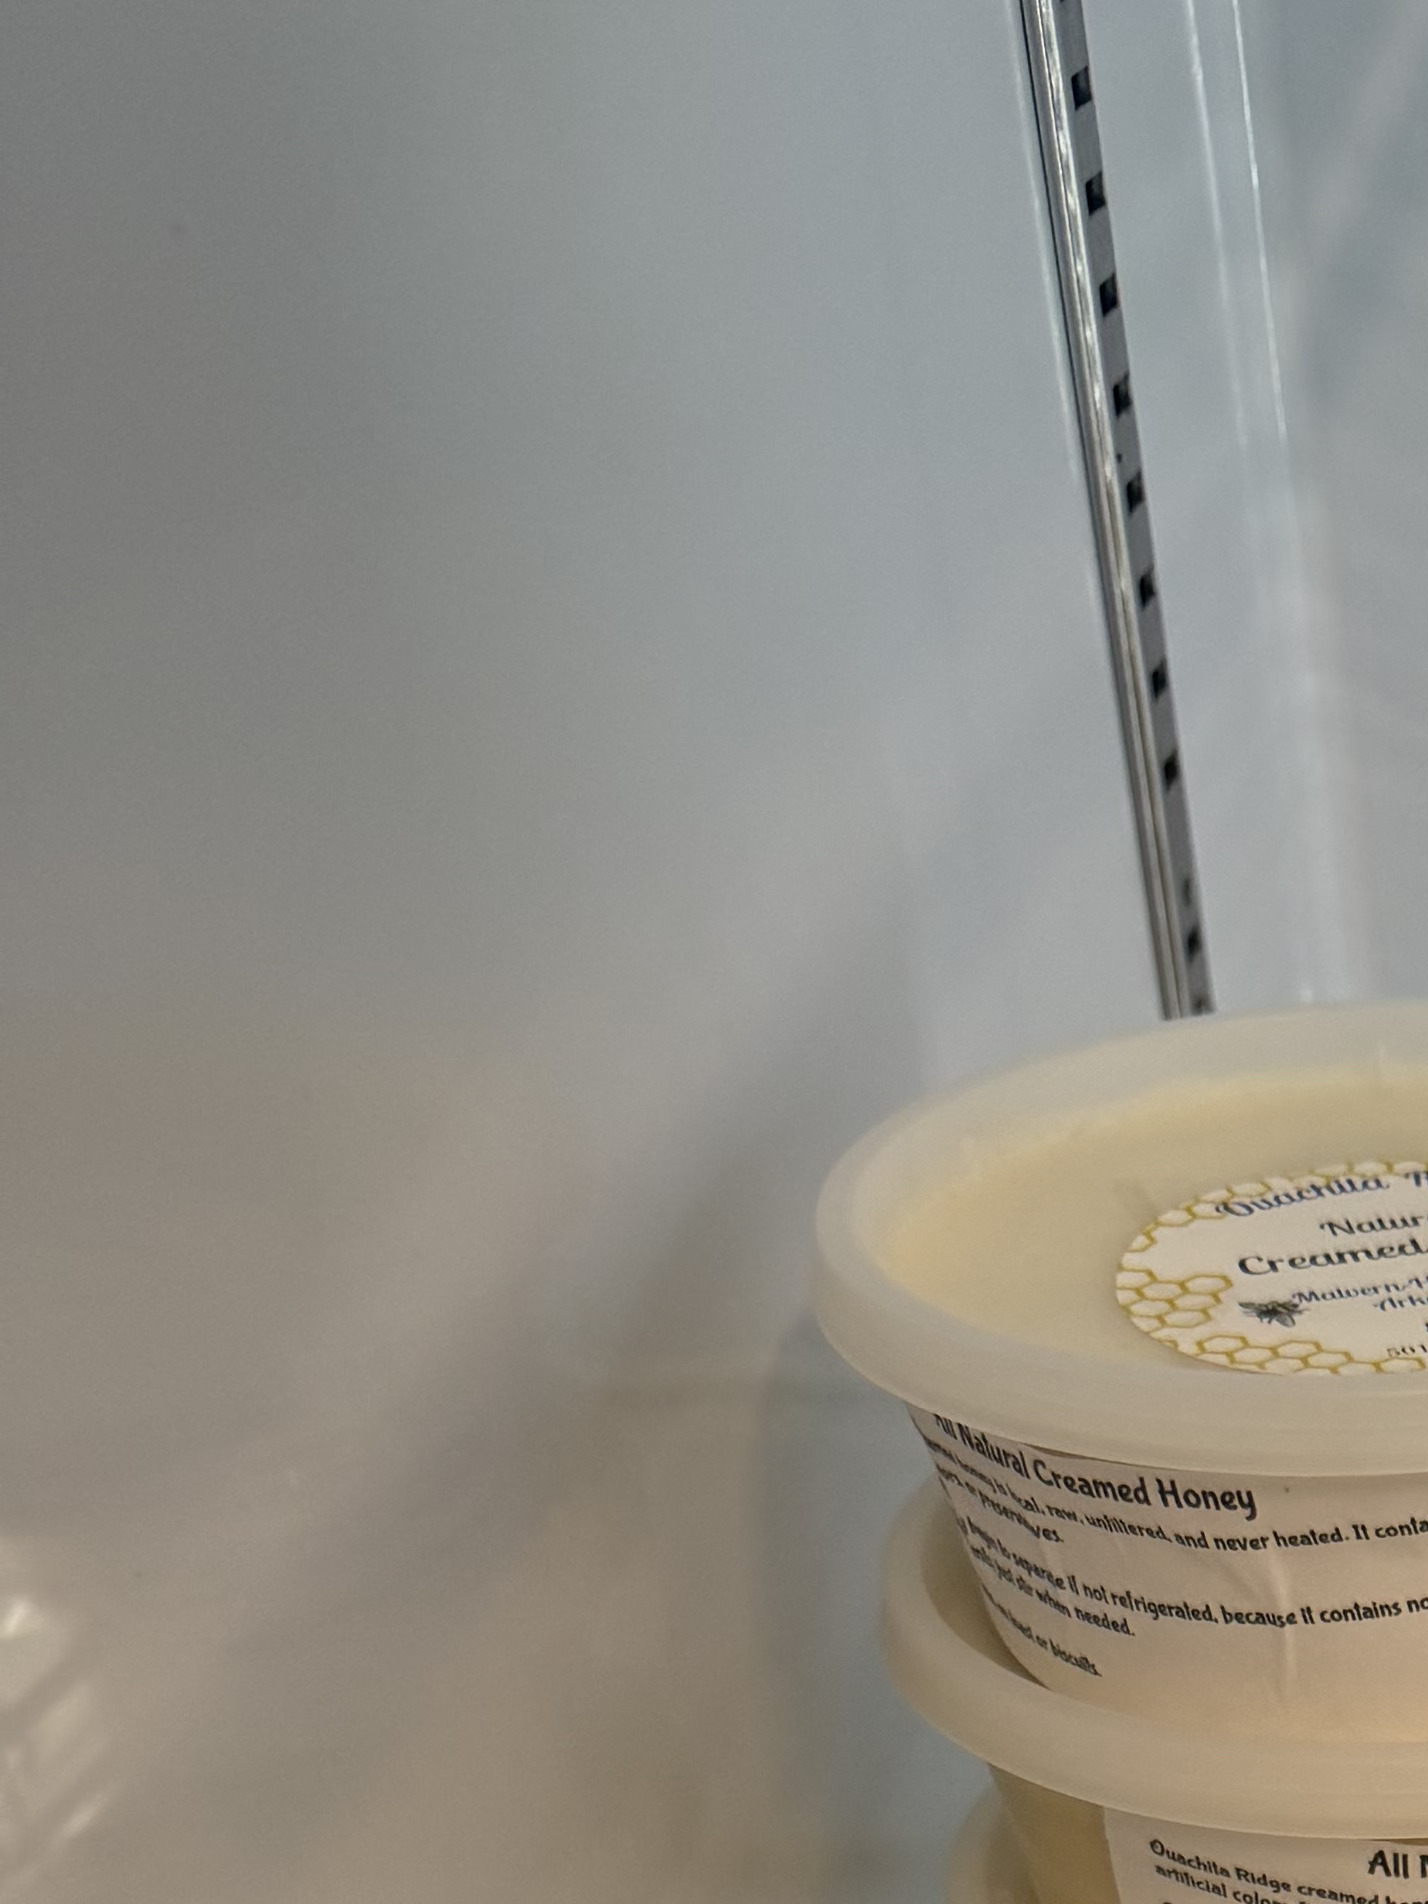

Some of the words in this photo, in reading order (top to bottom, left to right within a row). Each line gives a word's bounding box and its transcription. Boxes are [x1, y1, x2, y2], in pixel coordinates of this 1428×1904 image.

[1215, 1173, 1390, 1216] Ouachita
[956, 1421, 1030, 1478] Natural
[1033, 1460, 1149, 1508] Creamed
[1158, 1478, 1257, 1520] Honey
[1175, 1527, 1209, 1550] and
[1214, 1530, 1270, 1552] never
[1274, 1526, 1348, 1549] heated.
[1353, 1523, 1371, 1541] It
[1222, 1607, 1297, 1628] because
[1301, 1607, 1316, 1625] it
[1319, 1601, 1402, 1622] contains
[1368, 1850, 1410, 1879] All
[1155, 1865, 1228, 1899] artificial
